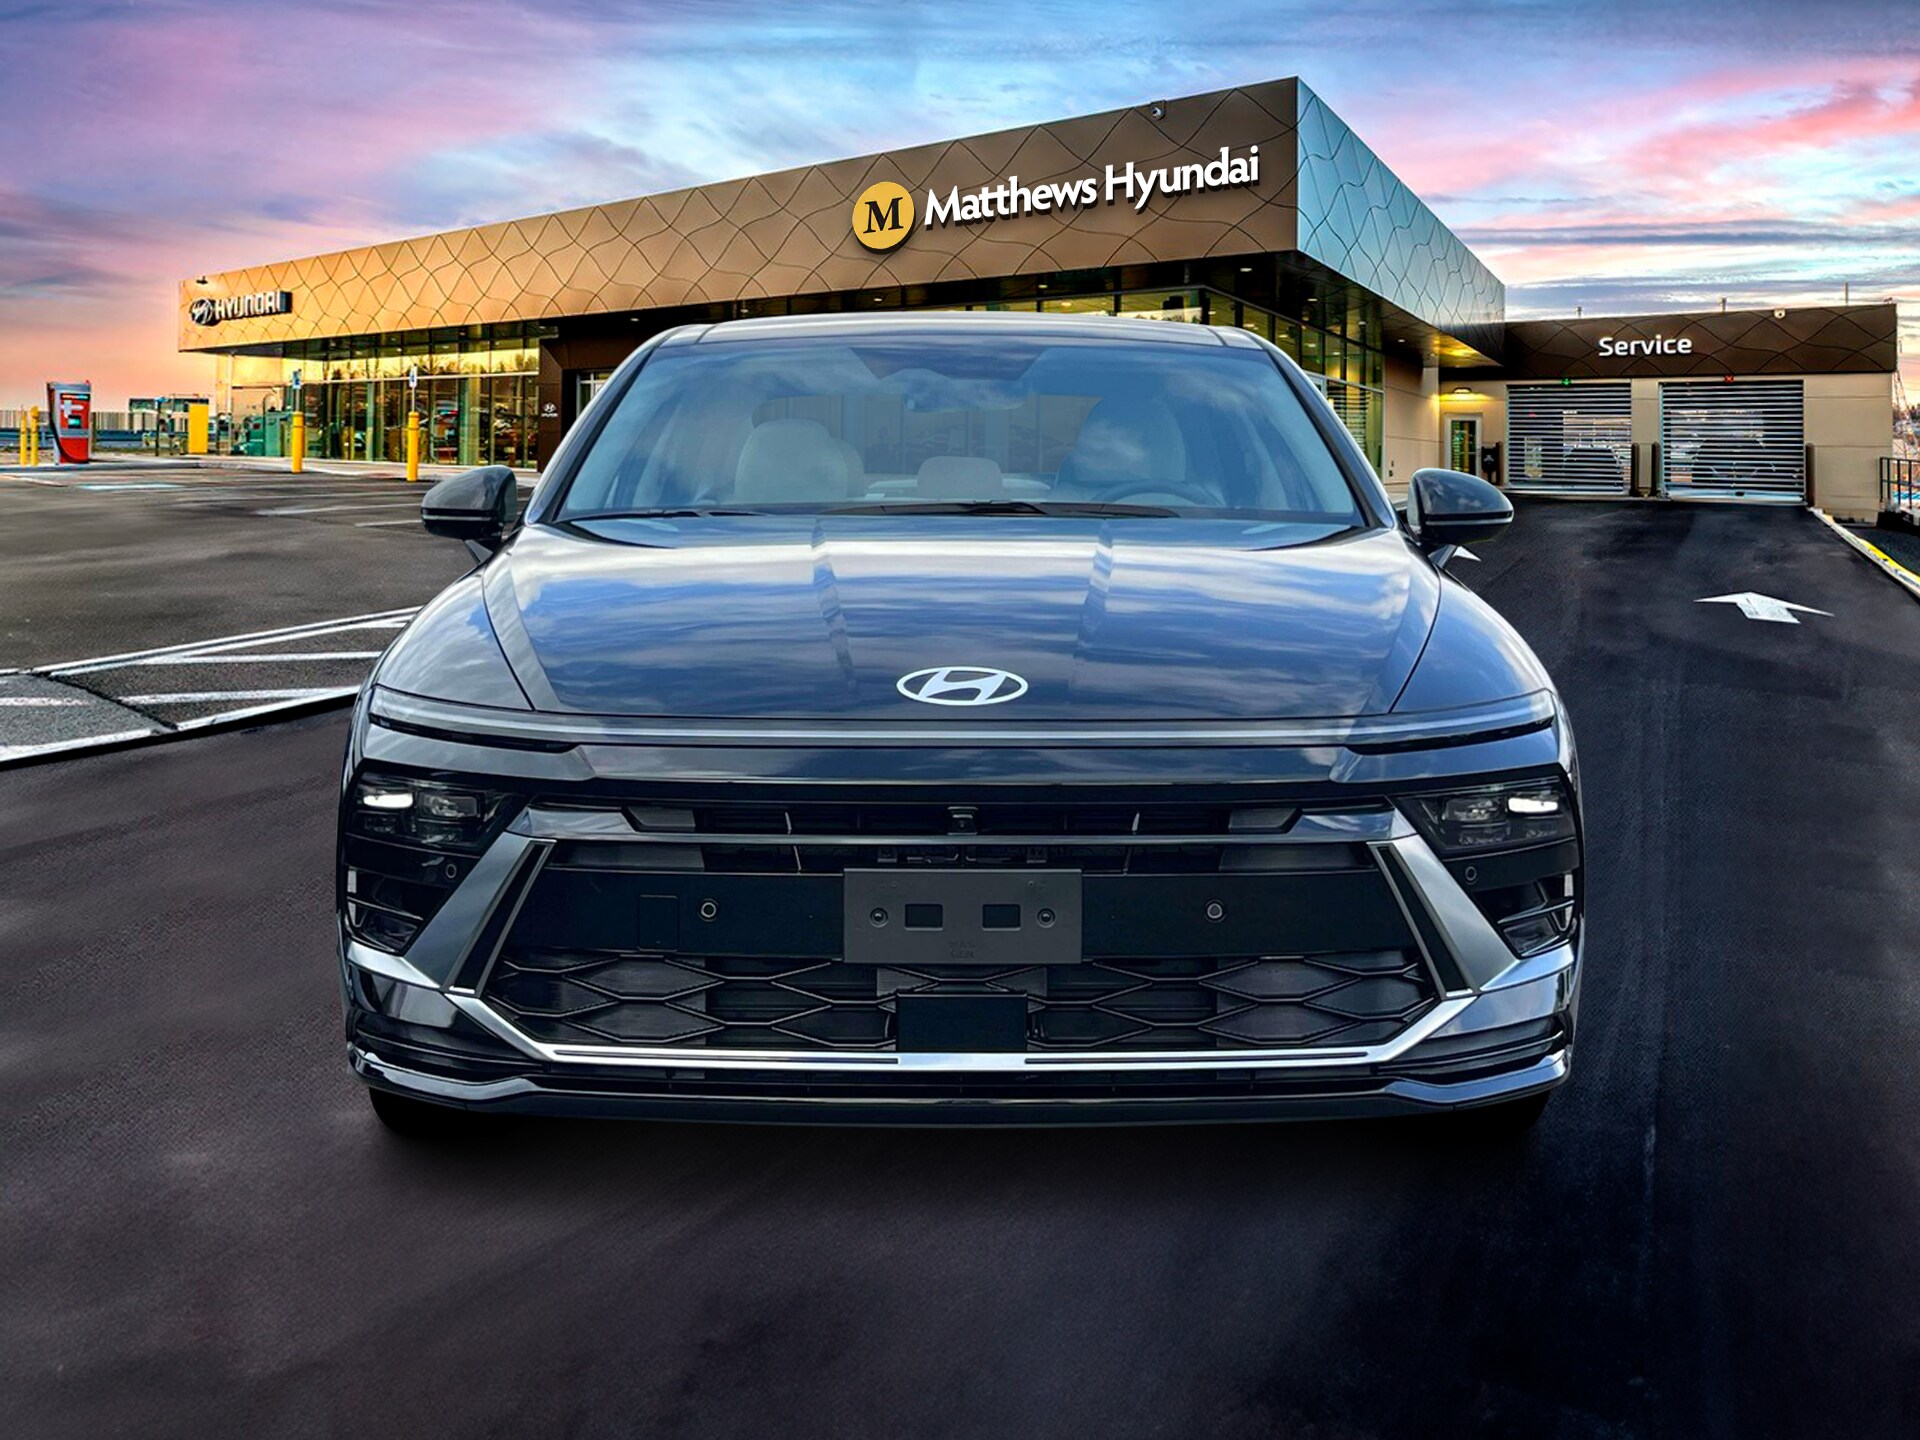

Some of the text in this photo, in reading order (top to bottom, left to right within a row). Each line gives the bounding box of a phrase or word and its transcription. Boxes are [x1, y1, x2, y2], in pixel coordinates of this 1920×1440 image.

[863, 145, 1259, 234] M Matthews Hyundai
[215, 290, 280, 319] HYUNDAI
[1598, 334, 1693, 356] Service
